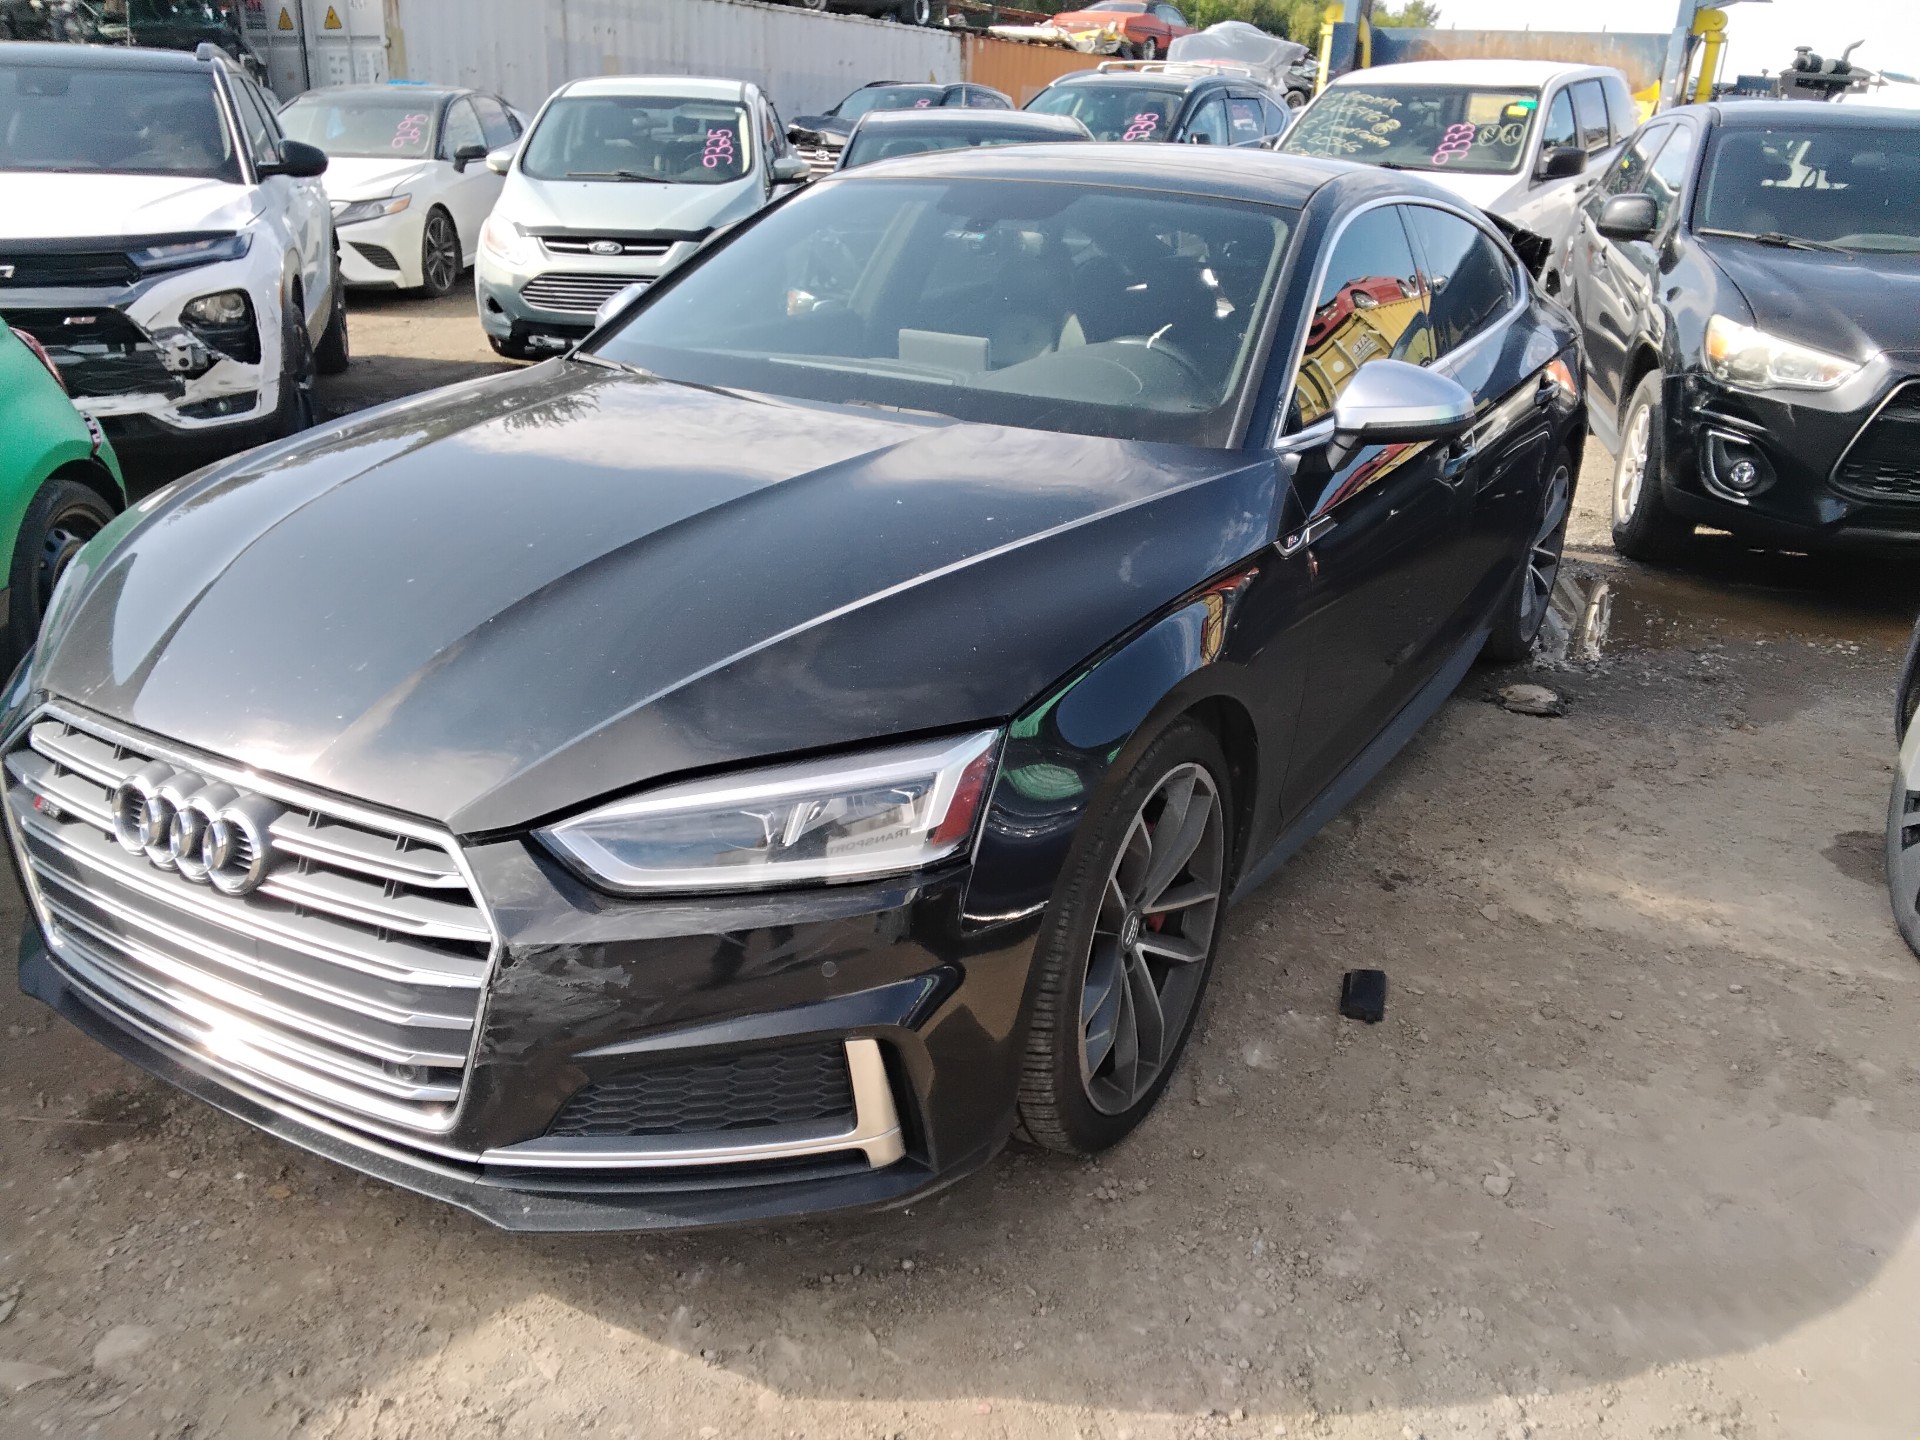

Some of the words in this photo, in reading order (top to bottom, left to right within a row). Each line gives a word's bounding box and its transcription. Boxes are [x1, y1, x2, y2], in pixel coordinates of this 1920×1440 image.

[1123, 113, 1159, 141] 9315
[1432, 123, 1475, 165] 9333
[703, 129, 733, 168] 9325
